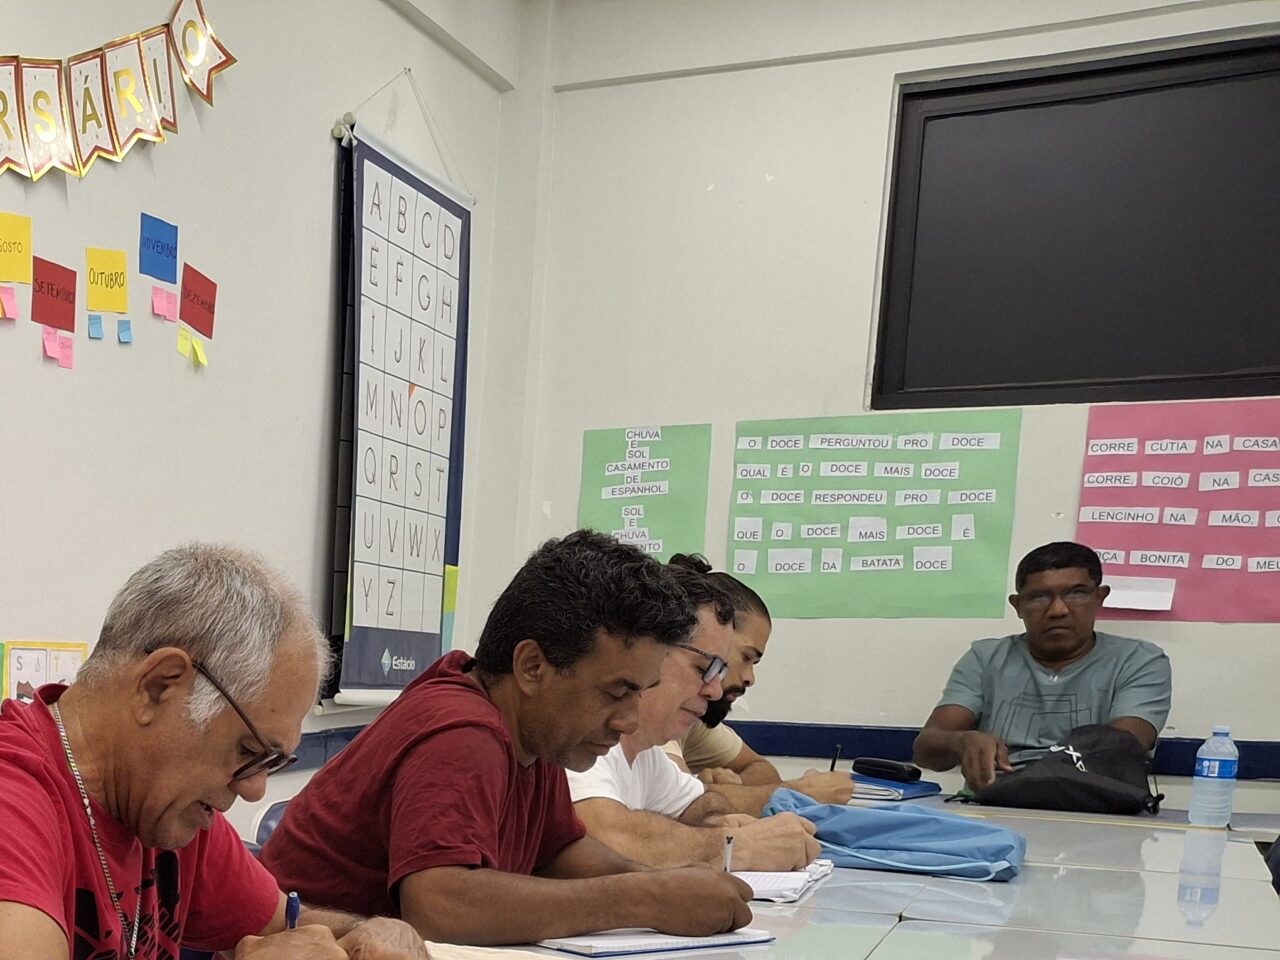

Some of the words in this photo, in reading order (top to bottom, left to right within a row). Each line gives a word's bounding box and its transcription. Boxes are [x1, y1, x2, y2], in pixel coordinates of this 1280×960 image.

[370, 181, 382, 221] A
[397, 195, 407, 233] B
[421, 212, 432, 248] C
[444, 224, 455, 260] D
[89, 268, 125, 289] OUTUBRO
[370, 243, 379, 287] E
[395, 256, 403, 296] F
[418, 274, 431, 311] G
[441, 286, 452, 323] H
[394, 328, 403, 363] J
[418, 336, 426, 374] K
[440, 347, 447, 383] L
[366, 379, 377, 420] M
[391, 390, 402, 428] N
[414, 400, 426, 436] O
[438, 408, 446, 441] P
[626, 430, 660, 440] CHUVA
[631, 440, 637, 448] E
[748, 439, 757, 448] O
[770, 439, 801, 449] DOCE
[820, 437, 888, 448] PERGUNTOU
[904, 438, 928, 448] PRO
[951, 437, 984, 447] DOCE
[1090, 442, 1134, 453] CORRE
[1150, 441, 1188, 451] CUTIA
[1205, 440, 1223, 449] NA
[1242, 439, 1278, 449] CASA
[628, 450, 647, 459] SOL
[607, 460, 669, 473] CASAMENTO
[740, 468, 768, 478] QUAL
[801, 464, 810, 473] O
[830, 464, 862, 473] DOCE
[884, 466, 910, 476] MAIS
[924, 468, 956, 477] DOCE
[364, 447, 376, 485] Q
[390, 454, 398, 491] R
[414, 462, 423, 498] S
[436, 464, 444, 502] T
[625, 475, 639, 484] DE
[1151, 474, 1184, 486] COIÓ
[1212, 478, 1230, 487] NA
[611, 485, 665, 496] ESPANHOL
[740, 492, 749, 500] O
[771, 492, 801, 502] DOCE
[814, 493, 883, 502] RESPONDEU
[904, 493, 928, 502] PRO
[960, 492, 993, 501] DOCE
[623, 508, 643, 516] SOL
[1091, 511, 1155, 522] LENCINHO
[1169, 513, 1186, 522] NA
[629, 519, 635, 527] E
[364, 512, 374, 549] U
[387, 518, 398, 553] V
[409, 522, 423, 558] W
[432, 528, 440, 562] X
[613, 531, 647, 540] CHUVA
[736, 530, 759, 540] QUE
[775, 529, 784, 537] O
[807, 526, 838, 536] DOCE
[858, 531, 885, 540] MAIS
[907, 526, 940, 535] DOCE
[963, 527, 970, 537] É
[737, 563, 745, 571] O
[775, 562, 805, 571] DOCE
[822, 561, 837, 571] DA
[861, 558, 901, 568] BATATA
[915, 560, 948, 569] DOCE
[1140, 553, 1185, 564] BONITA
[1215, 557, 1235, 566] DO
[362, 576, 372, 612] Y
[386, 578, 396, 616] Z
[16, 655, 23, 671] S
